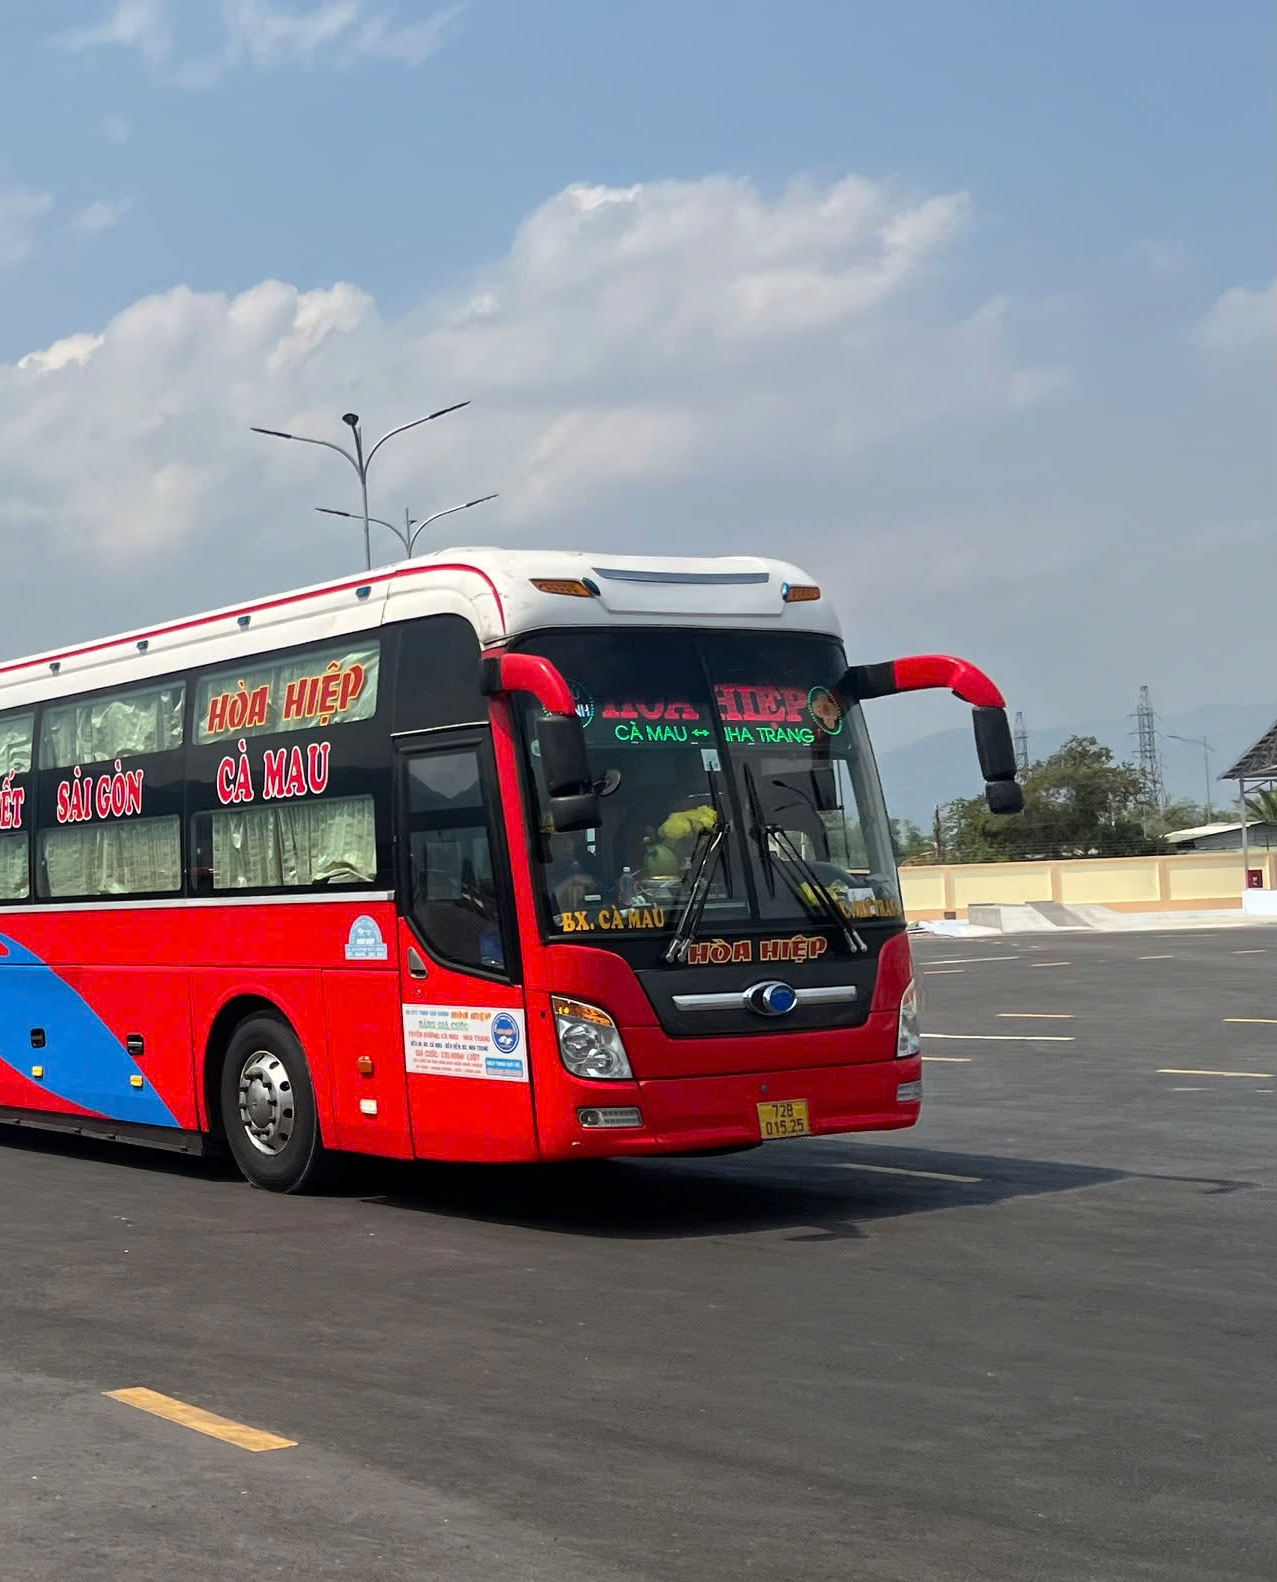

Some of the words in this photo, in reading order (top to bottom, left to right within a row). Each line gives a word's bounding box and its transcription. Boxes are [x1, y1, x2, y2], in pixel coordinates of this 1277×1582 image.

[206, 680, 270, 734] HÒA
[282, 660, 365, 726] HIỆP
[615, 720, 644, 741] CÀ
[646, 725, 688, 742] MAU
[756, 727, 815, 744] TRANG
[216, 738, 255, 805] CÀ
[262, 741, 331, 800] MAU
[57, 765, 93, 823] SÀI
[95, 758, 144, 819] GÒN
[598, 904, 624, 929] CÀ
[688, 939, 752, 965] HÒA
[760, 934, 828, 963] HIỆP
[772, 1104, 793, 1119] 72B
[765, 1118, 804, 1136] 015.25
